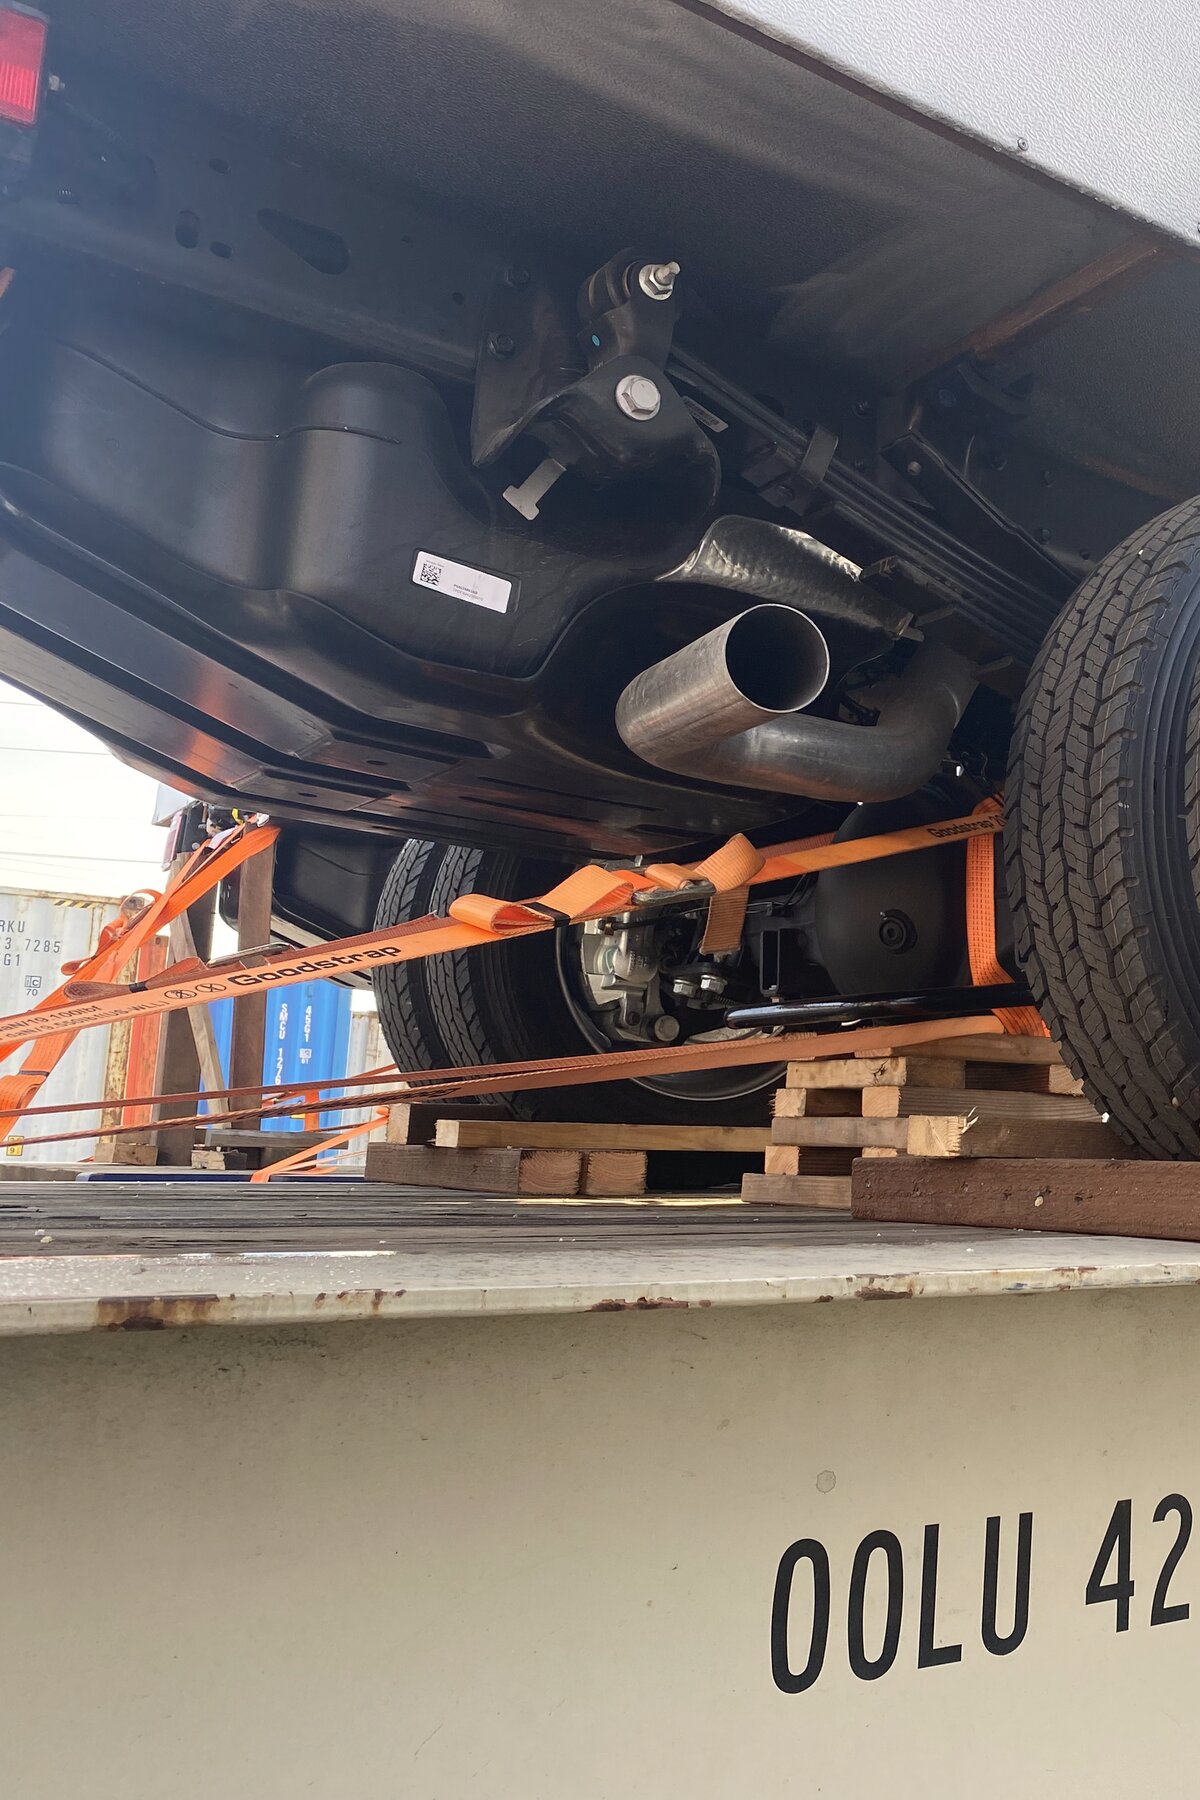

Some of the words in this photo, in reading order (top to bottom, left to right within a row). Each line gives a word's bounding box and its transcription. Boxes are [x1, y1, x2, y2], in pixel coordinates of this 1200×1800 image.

[24, 938, 61, 954] 7285
[226, 945, 403, 987] Goodstrap
[770, 1511, 1034, 1695] OOLU
